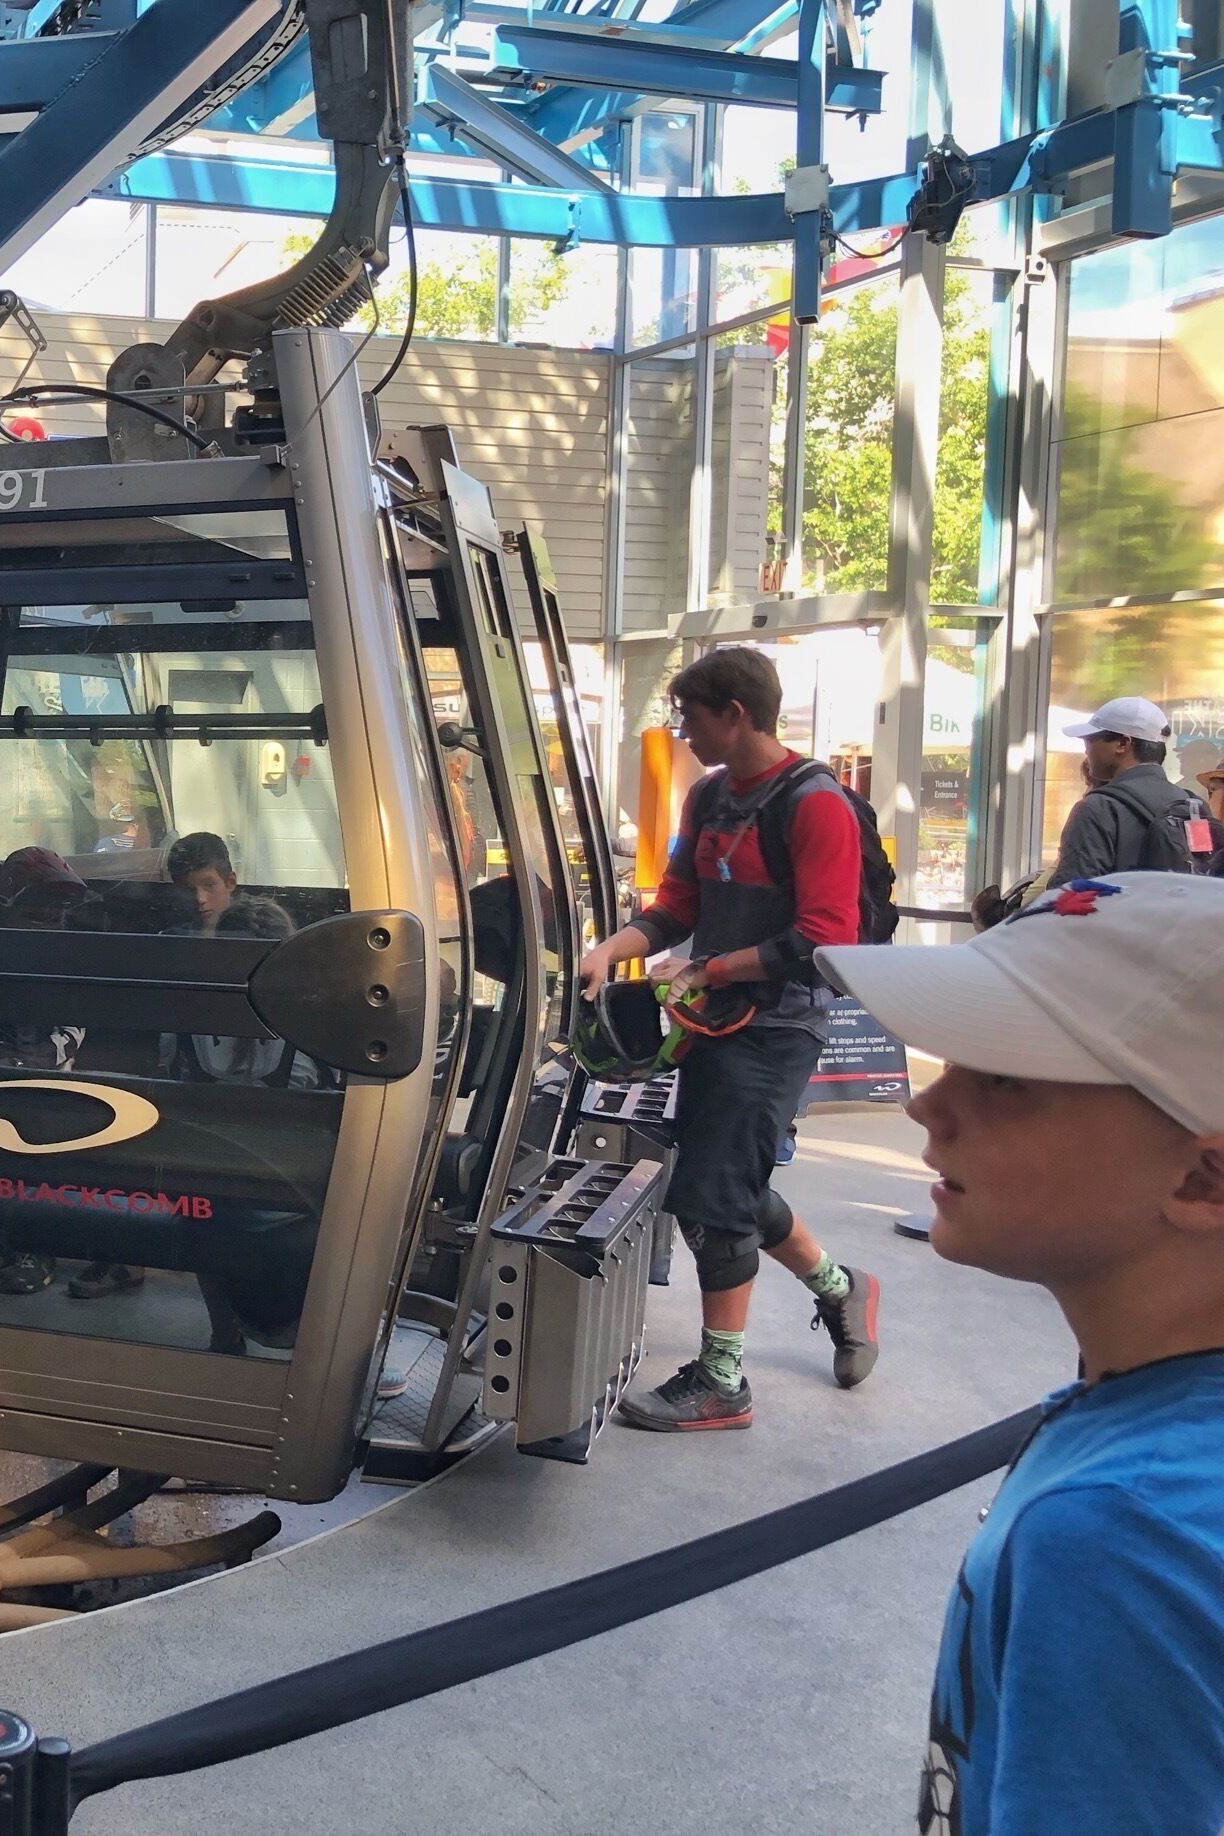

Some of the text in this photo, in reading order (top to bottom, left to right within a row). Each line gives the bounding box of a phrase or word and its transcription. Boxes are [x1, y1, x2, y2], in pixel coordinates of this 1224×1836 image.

[935, 780, 959, 788] Tickets &
[934, 790, 958, 799] Entrance
[838, 1037, 854, 1045] stops
[868, 1035, 886, 1044] speed
[845, 1046, 871, 1054] common
